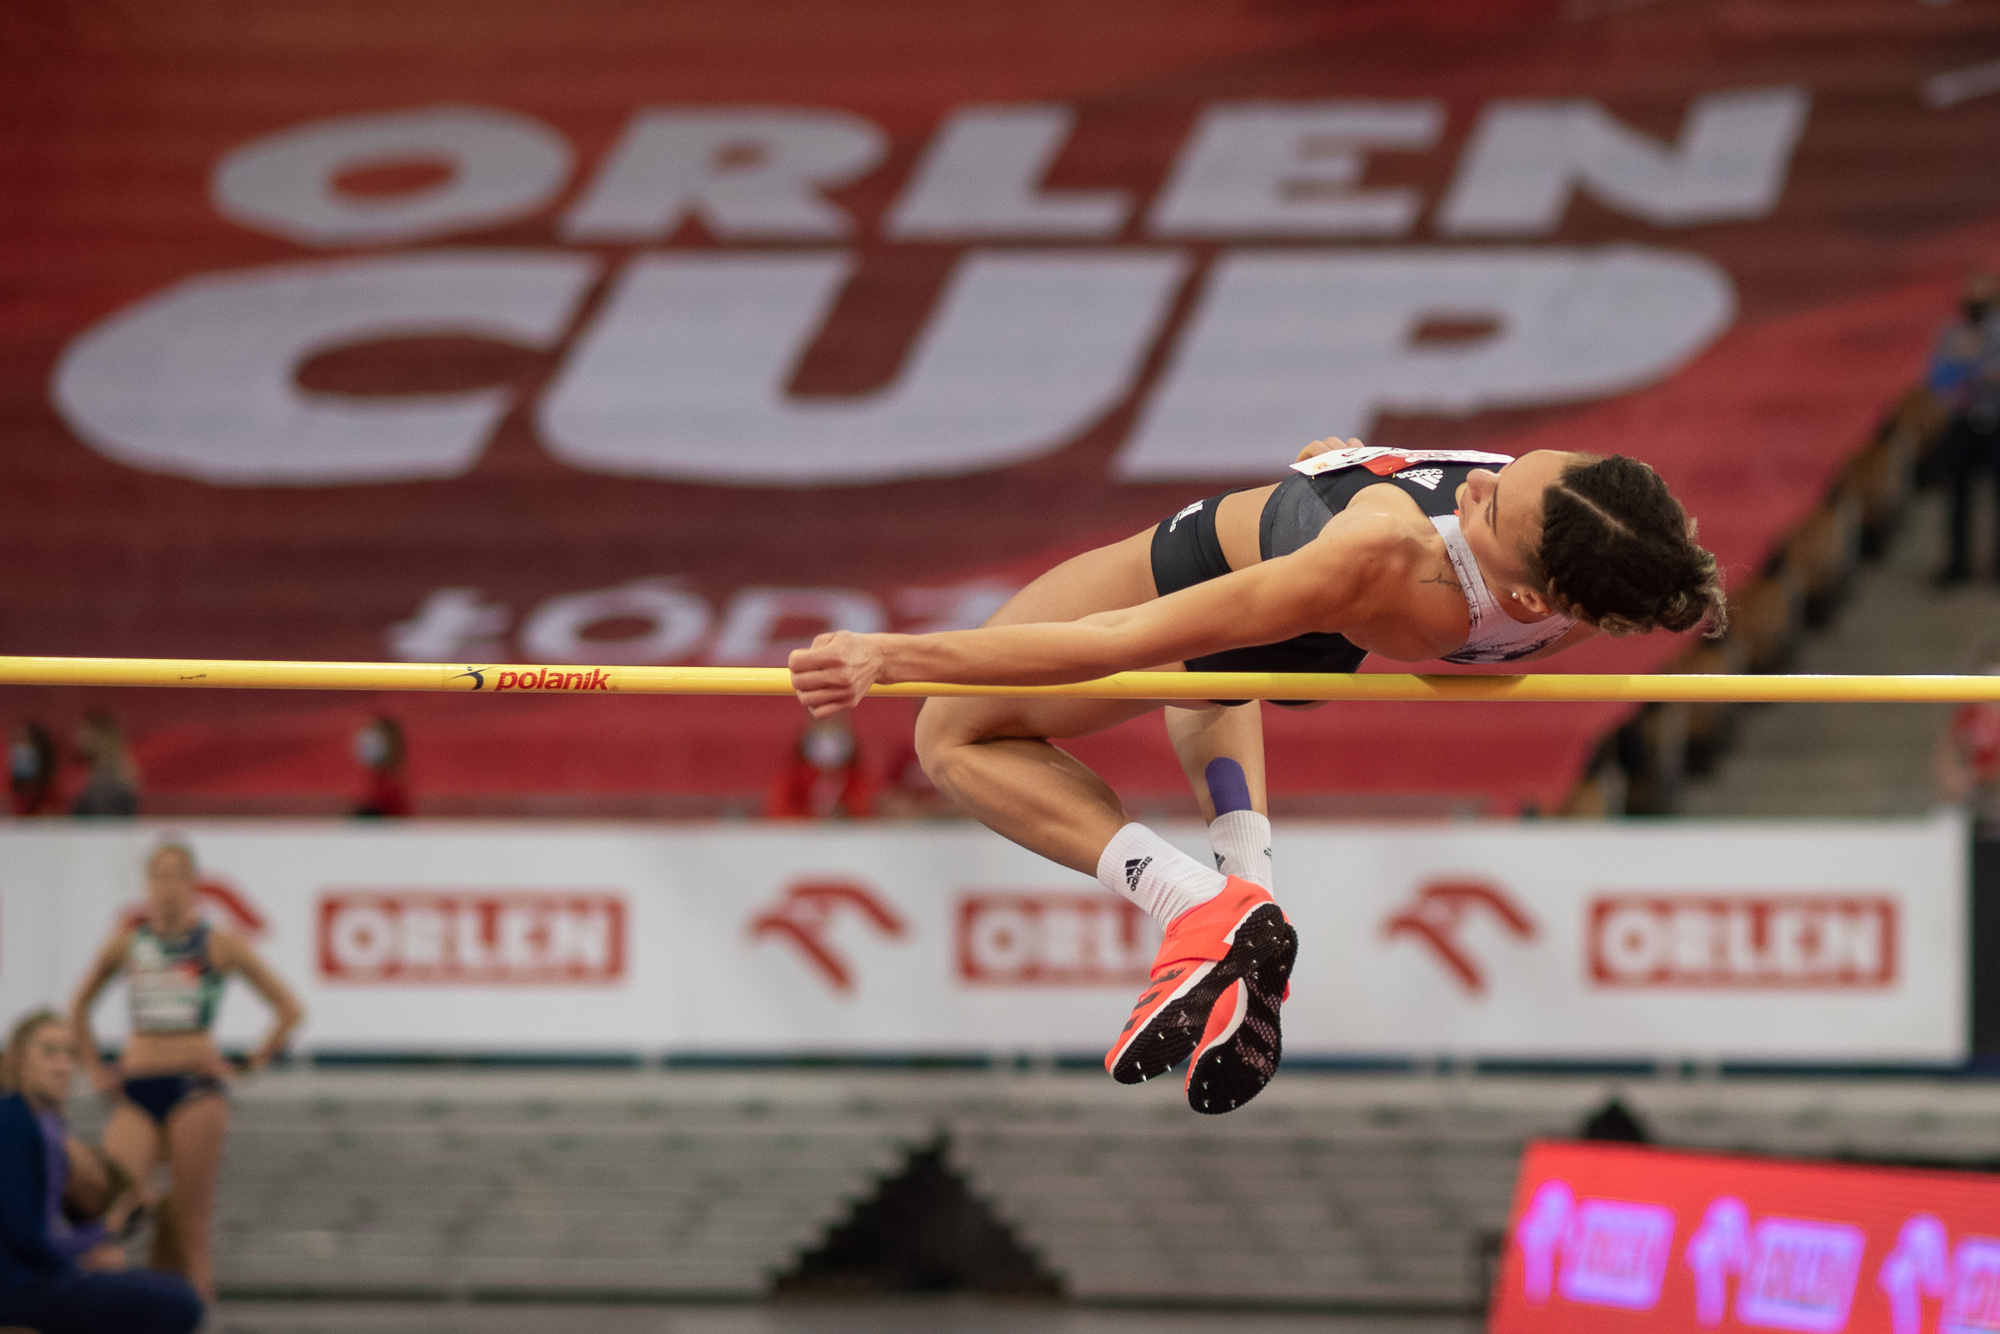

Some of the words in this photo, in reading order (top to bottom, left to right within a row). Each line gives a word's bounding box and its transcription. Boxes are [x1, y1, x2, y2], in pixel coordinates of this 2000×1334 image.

[212, 88, 1808, 245] ORLEN
[51, 246, 1737, 485] CUP
[1396, 468, 1443, 479] adidas
[494, 668, 611, 691] polanik
[1130, 856, 1153, 892] adidas
[328, 903, 608, 973] ORLEN
[970, 907, 1164, 972] ORL
[1602, 904, 1884, 973] ORLEN
